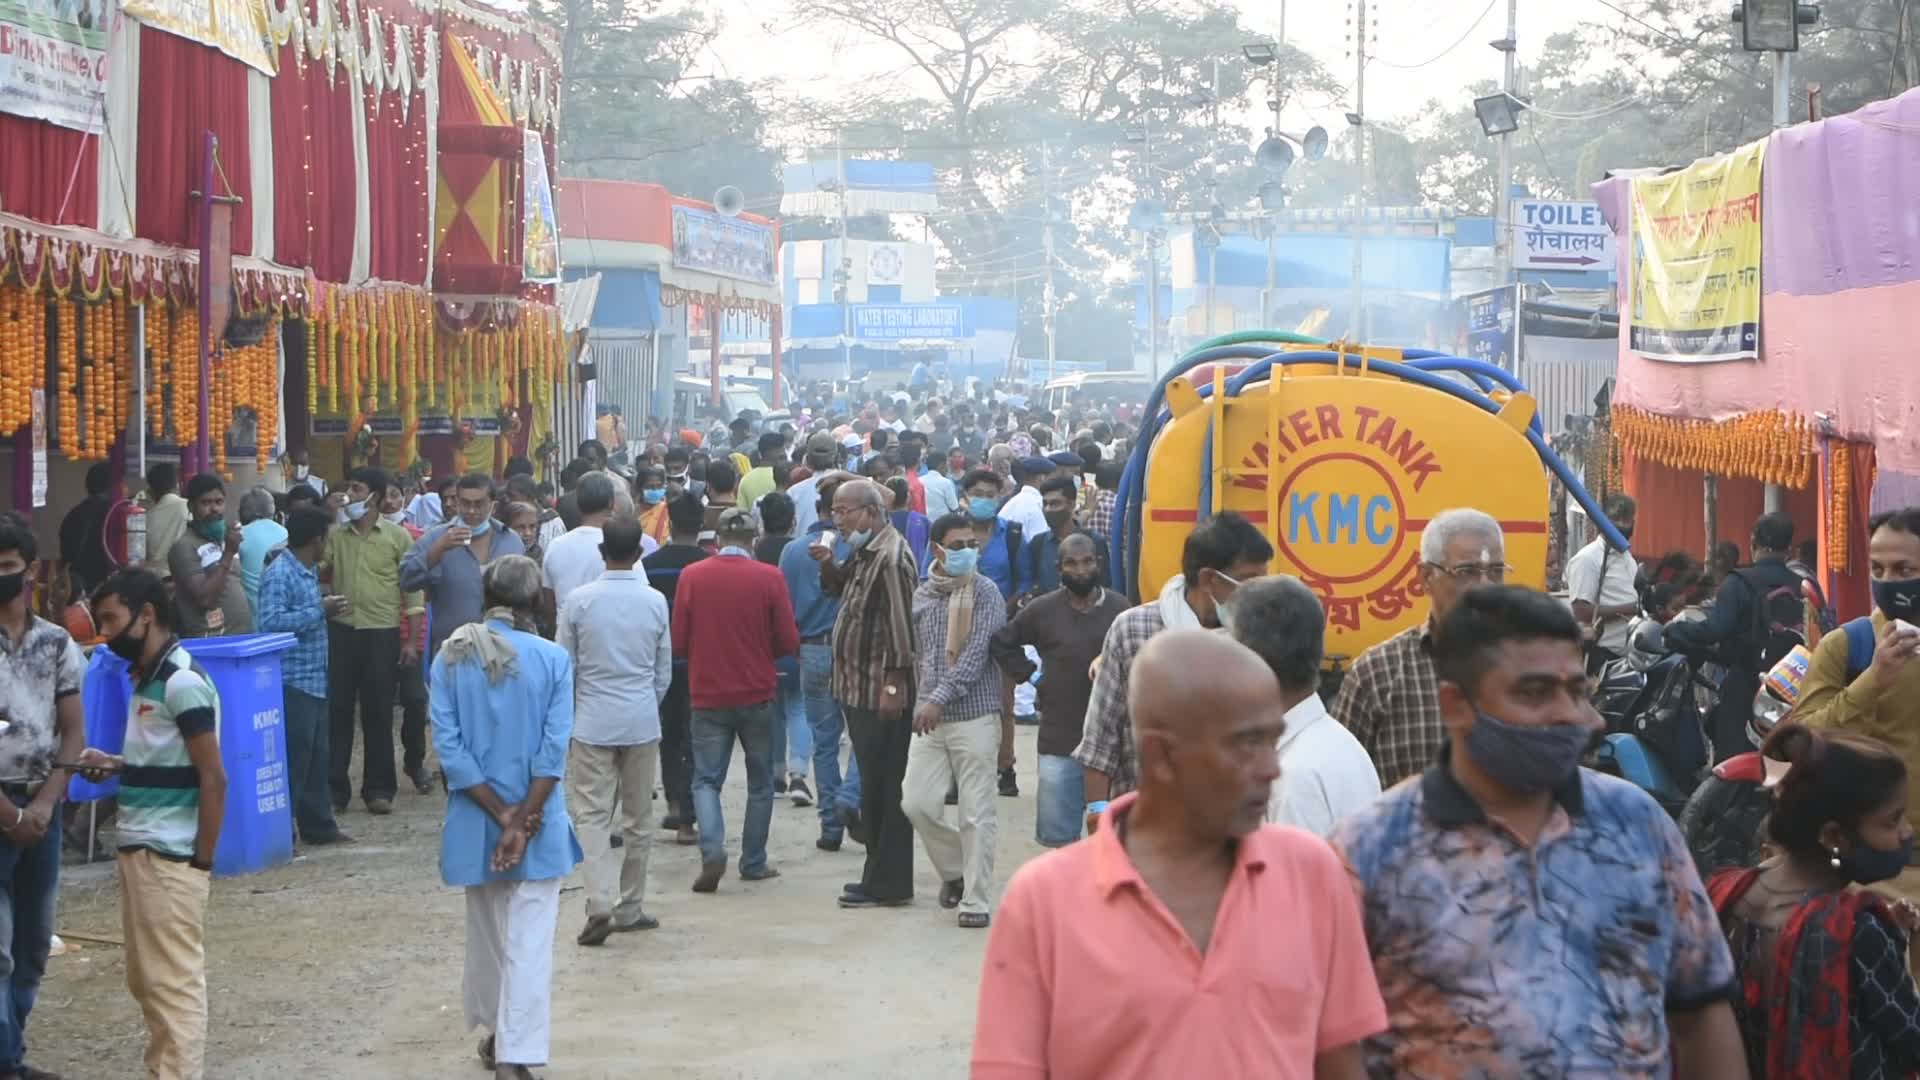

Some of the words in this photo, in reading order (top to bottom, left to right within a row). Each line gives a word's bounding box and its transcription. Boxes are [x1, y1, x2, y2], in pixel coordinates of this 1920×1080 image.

[1233, 404, 1344, 490] WATER
[1354, 405, 1442, 493] TANK
[1288, 491, 1394, 545] KMC
[253, 709, 280, 731] KMC
[257, 795, 275, 814] USE
